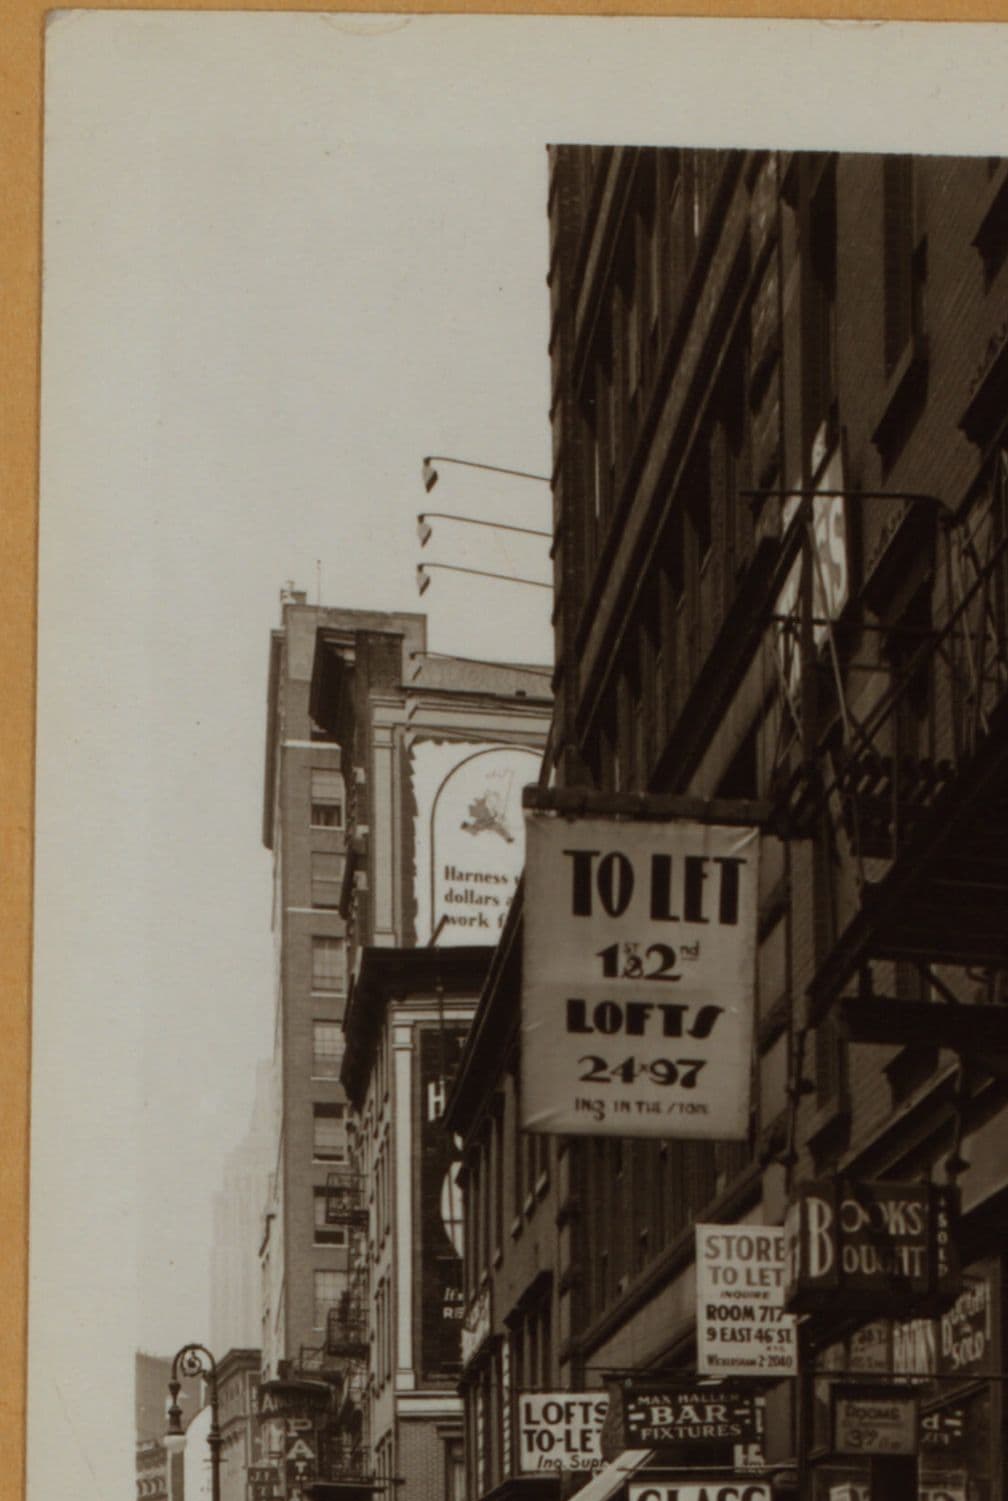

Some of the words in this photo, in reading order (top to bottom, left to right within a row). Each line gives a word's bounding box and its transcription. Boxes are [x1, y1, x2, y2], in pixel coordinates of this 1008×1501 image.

[444, 865, 508, 884] Harness
[444, 888, 500, 907] dollars
[562, 849, 635, 919] TO
[650, 853, 748, 926] LET
[446, 912, 489, 928] work
[566, 998, 726, 1040] LOFTS
[613, 1100, 632, 1114] IN
[637, 1101, 663, 1115] THE
[704, 1234, 785, 1262] STORE
[707, 1265, 738, 1286] TO
[745, 1266, 784, 1288] LET
[706, 1304, 755, 1322] ROOM
[758, 1305, 785, 1323] 717
[706, 1326, 718, 1342] 9
[719, 1327, 752, 1343] EAST
[524, 1401, 609, 1426] LOFTS
[650, 1403, 730, 1427] BAR
[522, 1428, 603, 1454] TO-LE
[640, 1424, 743, 1442] FIXTURES
